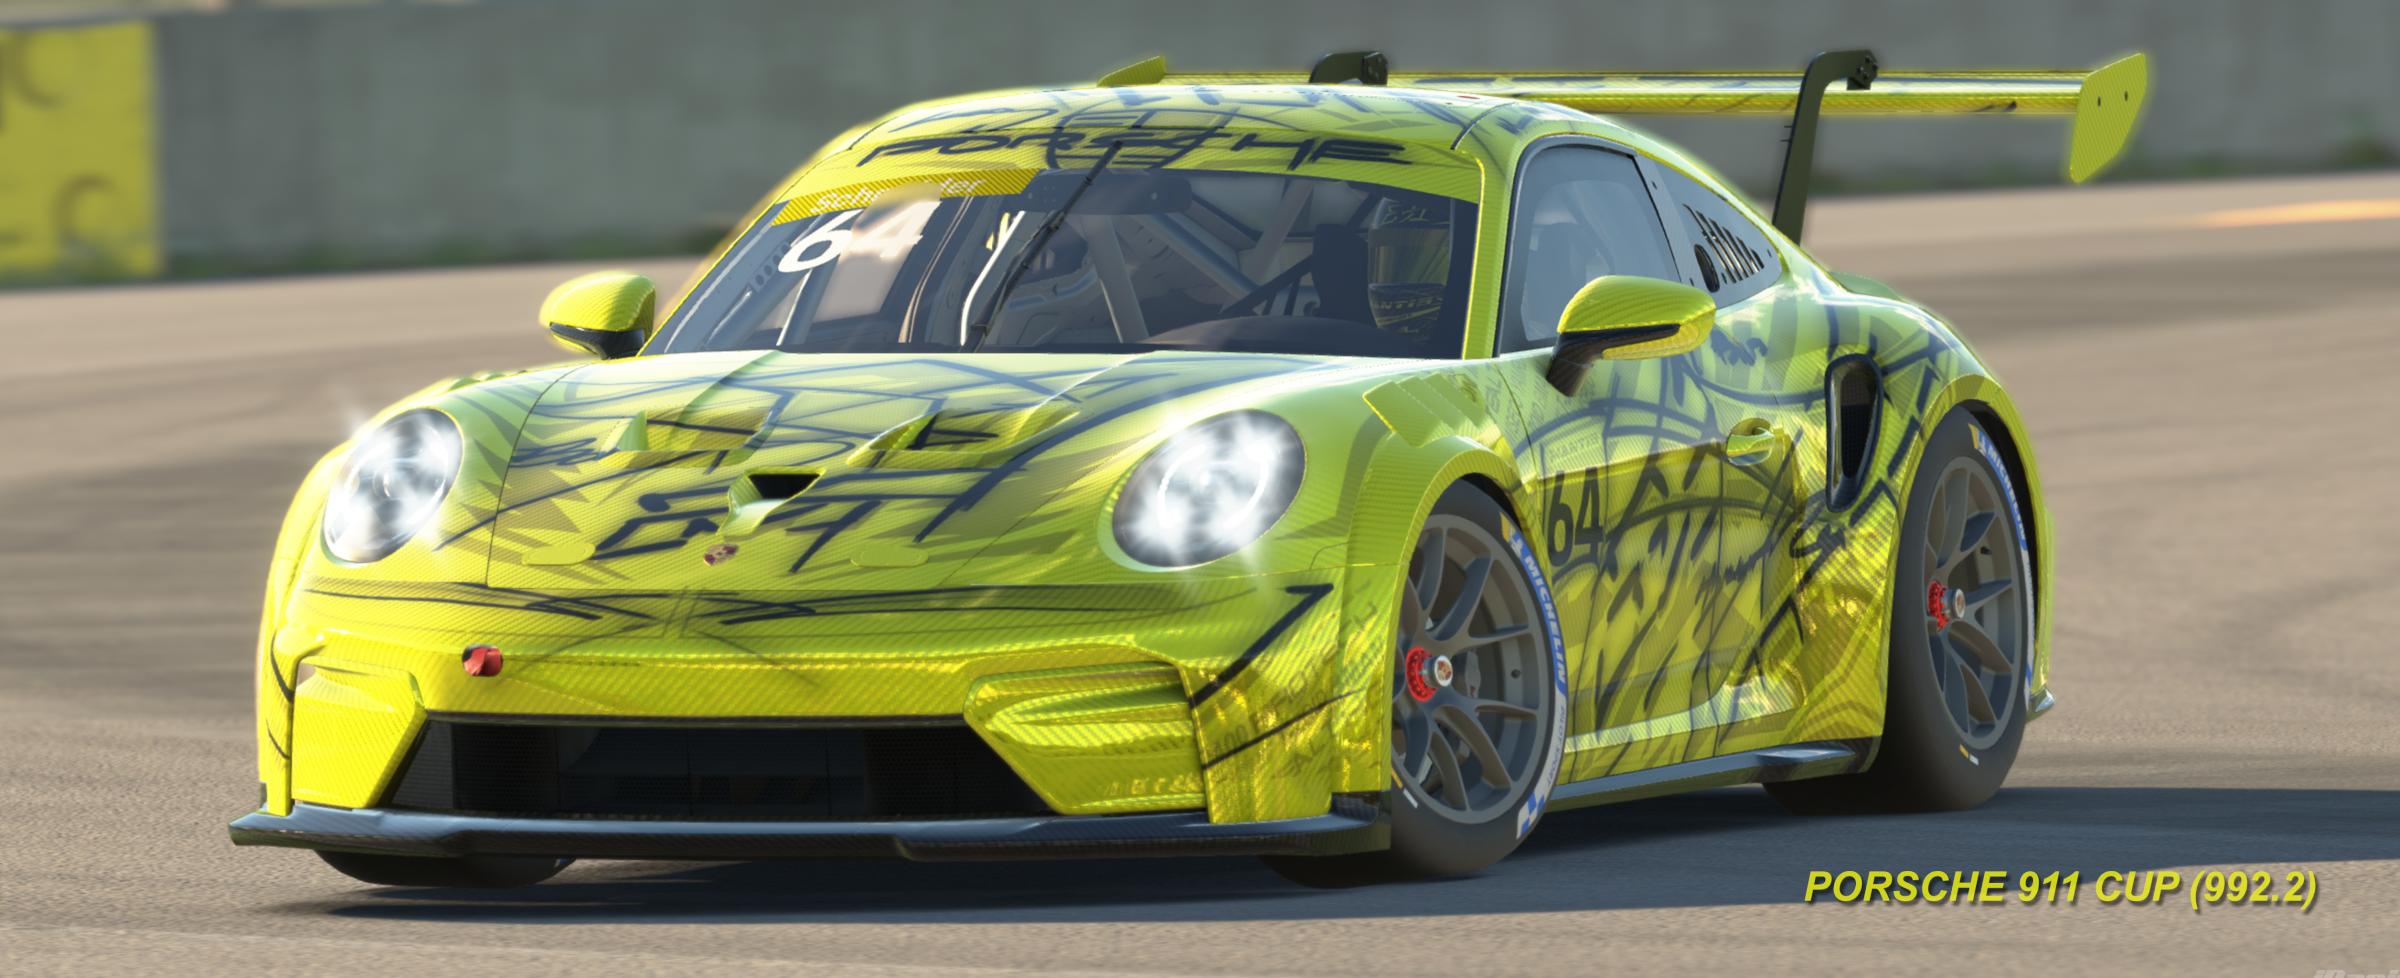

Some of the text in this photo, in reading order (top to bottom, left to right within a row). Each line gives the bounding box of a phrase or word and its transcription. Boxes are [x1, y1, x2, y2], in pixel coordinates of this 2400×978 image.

[856, 132, 1413, 171] PORSCHE
[778, 200, 942, 272] 64
[1550, 467, 1604, 567] 64
[1989, 449, 2027, 541] MICHELIN
[1523, 555, 1567, 686] MICHELIN
